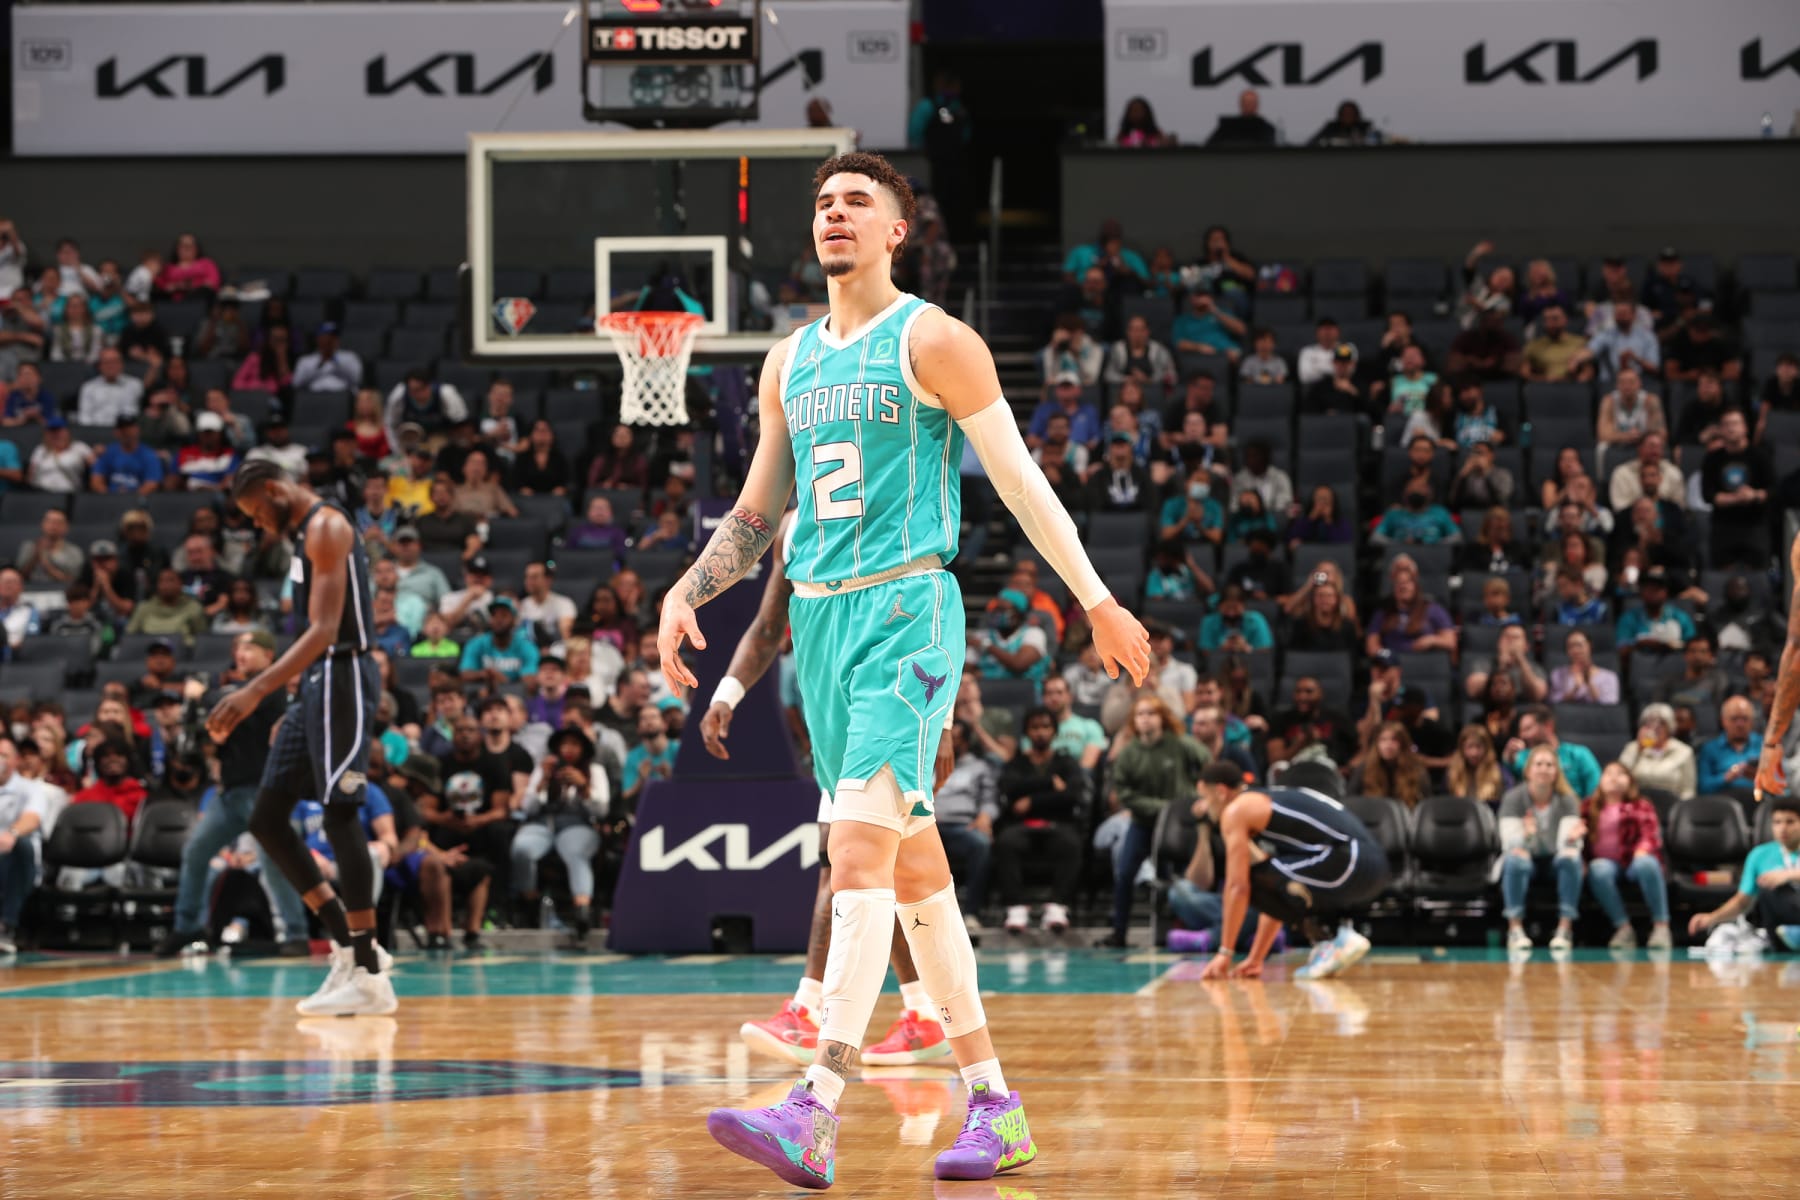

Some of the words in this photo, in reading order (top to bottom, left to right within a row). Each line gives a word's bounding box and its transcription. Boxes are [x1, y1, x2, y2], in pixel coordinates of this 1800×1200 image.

[635, 26, 747, 49] TISSOT
[96, 53, 286, 99] KIA
[365, 51, 555, 97] KIA
[1191, 42, 1384, 88] KIA
[1464, 39, 1659, 85] KIA
[786, 382, 903, 441] HORNETS
[811, 440, 865, 522] 2
[639, 822, 821, 872] KIA
